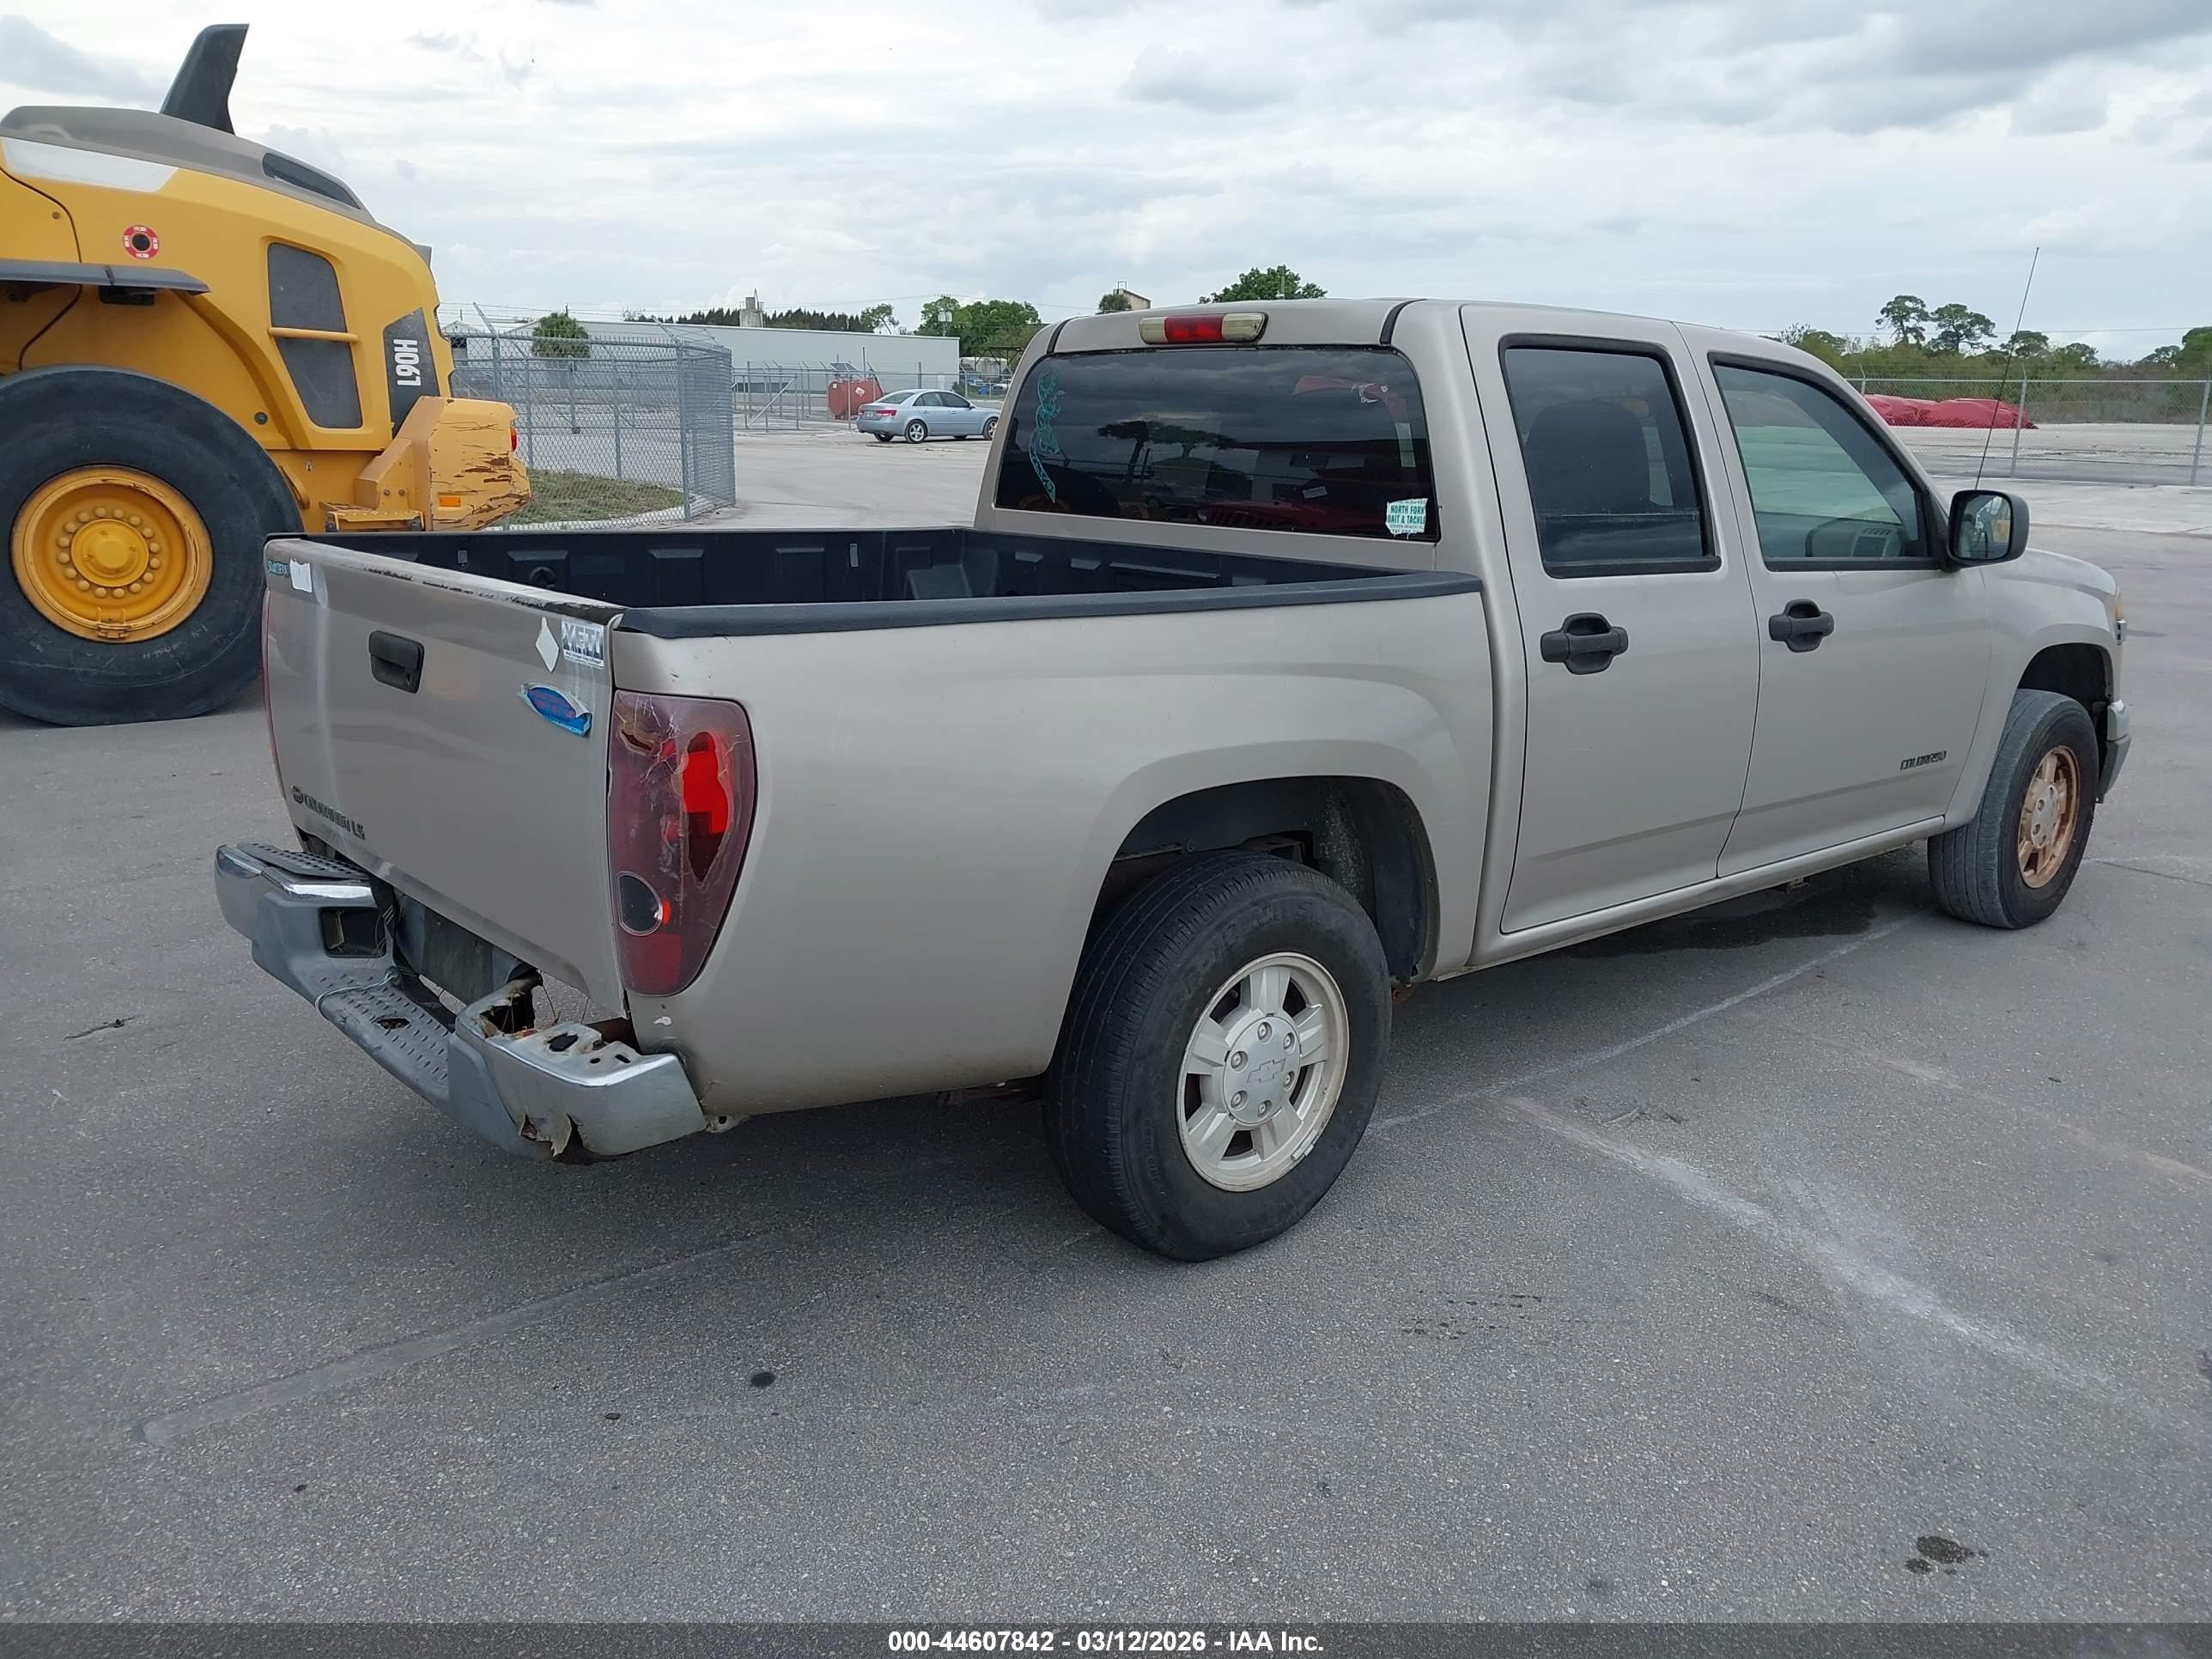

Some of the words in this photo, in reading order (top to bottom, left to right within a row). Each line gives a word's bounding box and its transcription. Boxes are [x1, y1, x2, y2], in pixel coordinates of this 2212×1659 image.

[393, 339, 421, 386] L90H
[1387, 514, 1400, 524] BAIT
[1401, 515, 1406, 524] &
[1390, 505, 1409, 514] NORTH
[1410, 506, 1425, 515] FORK
[563, 622, 602, 656] YETI
[350, 820, 366, 841] LS
